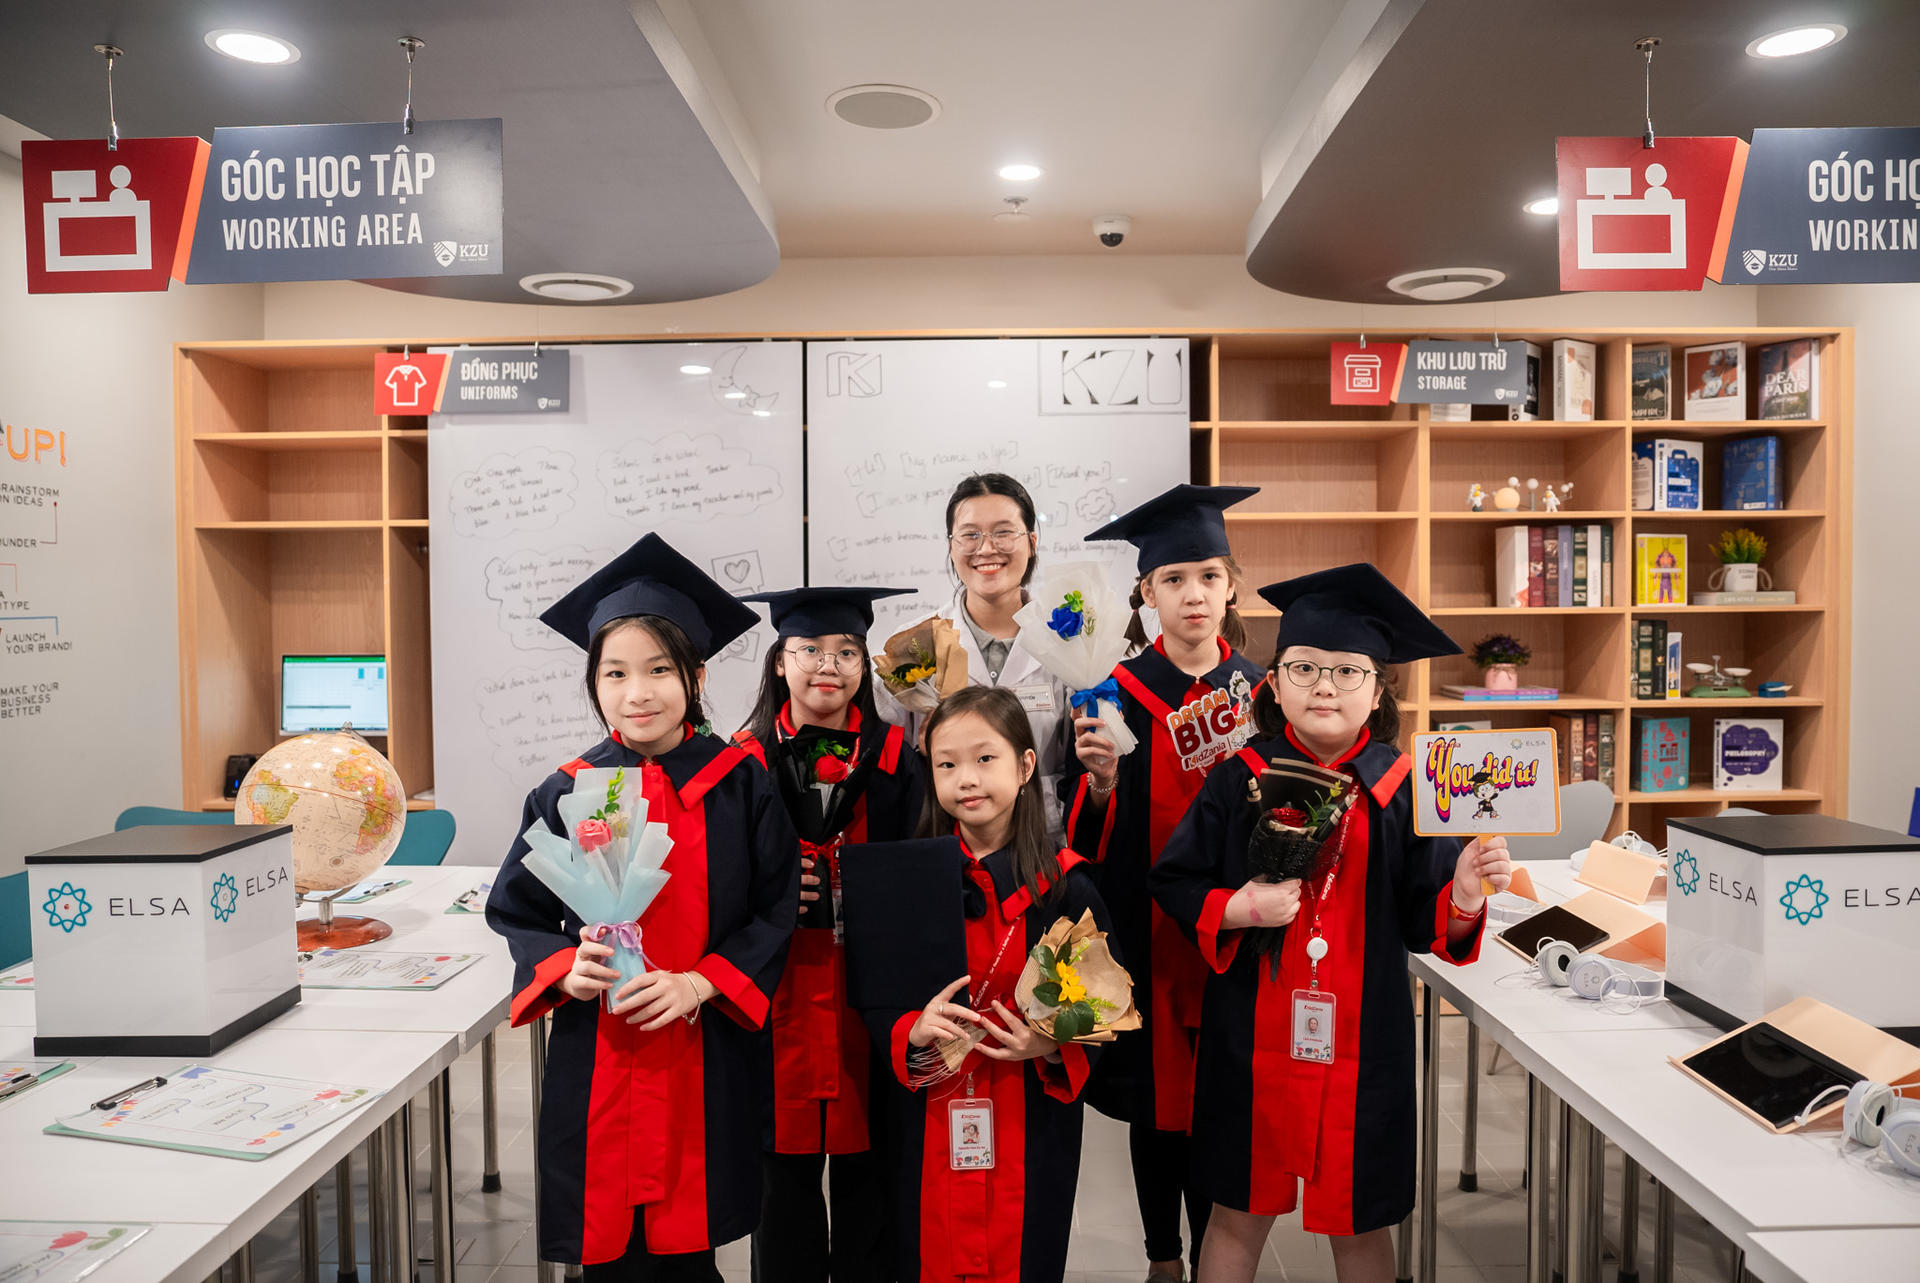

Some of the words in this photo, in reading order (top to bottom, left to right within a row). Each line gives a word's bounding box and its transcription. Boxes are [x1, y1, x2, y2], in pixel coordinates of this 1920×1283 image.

[221, 150, 285, 201] GÓC
[296, 155, 361, 207] HỌC
[370, 145, 435, 204] TẬP
[1808, 151, 1874, 202] GÓC
[1885, 158, 1920, 210] HỌ
[222, 216, 345, 251] WORKING
[356, 213, 423, 247] AREA
[1809, 219, 1918, 251] WORKIN
[460, 244, 488, 257] KZU
[1769, 254, 1798, 266] KZU
[1417, 352, 1446, 370] KHU
[1450, 350, 1476, 370] LƯU
[1480, 349, 1507, 370] TRỮ
[461, 357, 498, 381] ĐỒNG
[502, 362, 538, 383] PHỤC
[1062, 349, 1183, 405] KZU
[1418, 376, 1467, 390] STORAGE
[1764, 381, 1809, 397] PARIS
[461, 386, 518, 400] UNIFORMS
[0, 424, 66, 467] UP!
[0, 483, 60, 497] RAINSTORM
[14, 496, 43, 507] IDEAS
[0, 537, 37, 548] UNDER
[0, 601, 30, 611] TYPE
[6, 633, 46, 643] LAUNCH
[6, 644, 35, 654] YOUR
[39, 642, 73, 652] BRAND!
[1, 685, 28, 696] MAKE
[32, 682, 59, 692] YOUR
[1, 693, 51, 708] BUSINESS
[1, 705, 42, 719] BETTER
[1169, 689, 1229, 730] DREAM
[1174, 703, 1236, 756] BIG
[1184, 741, 1226, 770] KidZania
[1725, 749, 1766, 757] PHILOSOPHY
[1427, 738, 1474, 816] You
[1481, 752, 1512, 785] did
[1515, 759, 1539, 787] it!
[246, 866, 288, 897] ELSA
[1709, 873, 1758, 906] ELSA
[110, 898, 190, 916] ELSA
